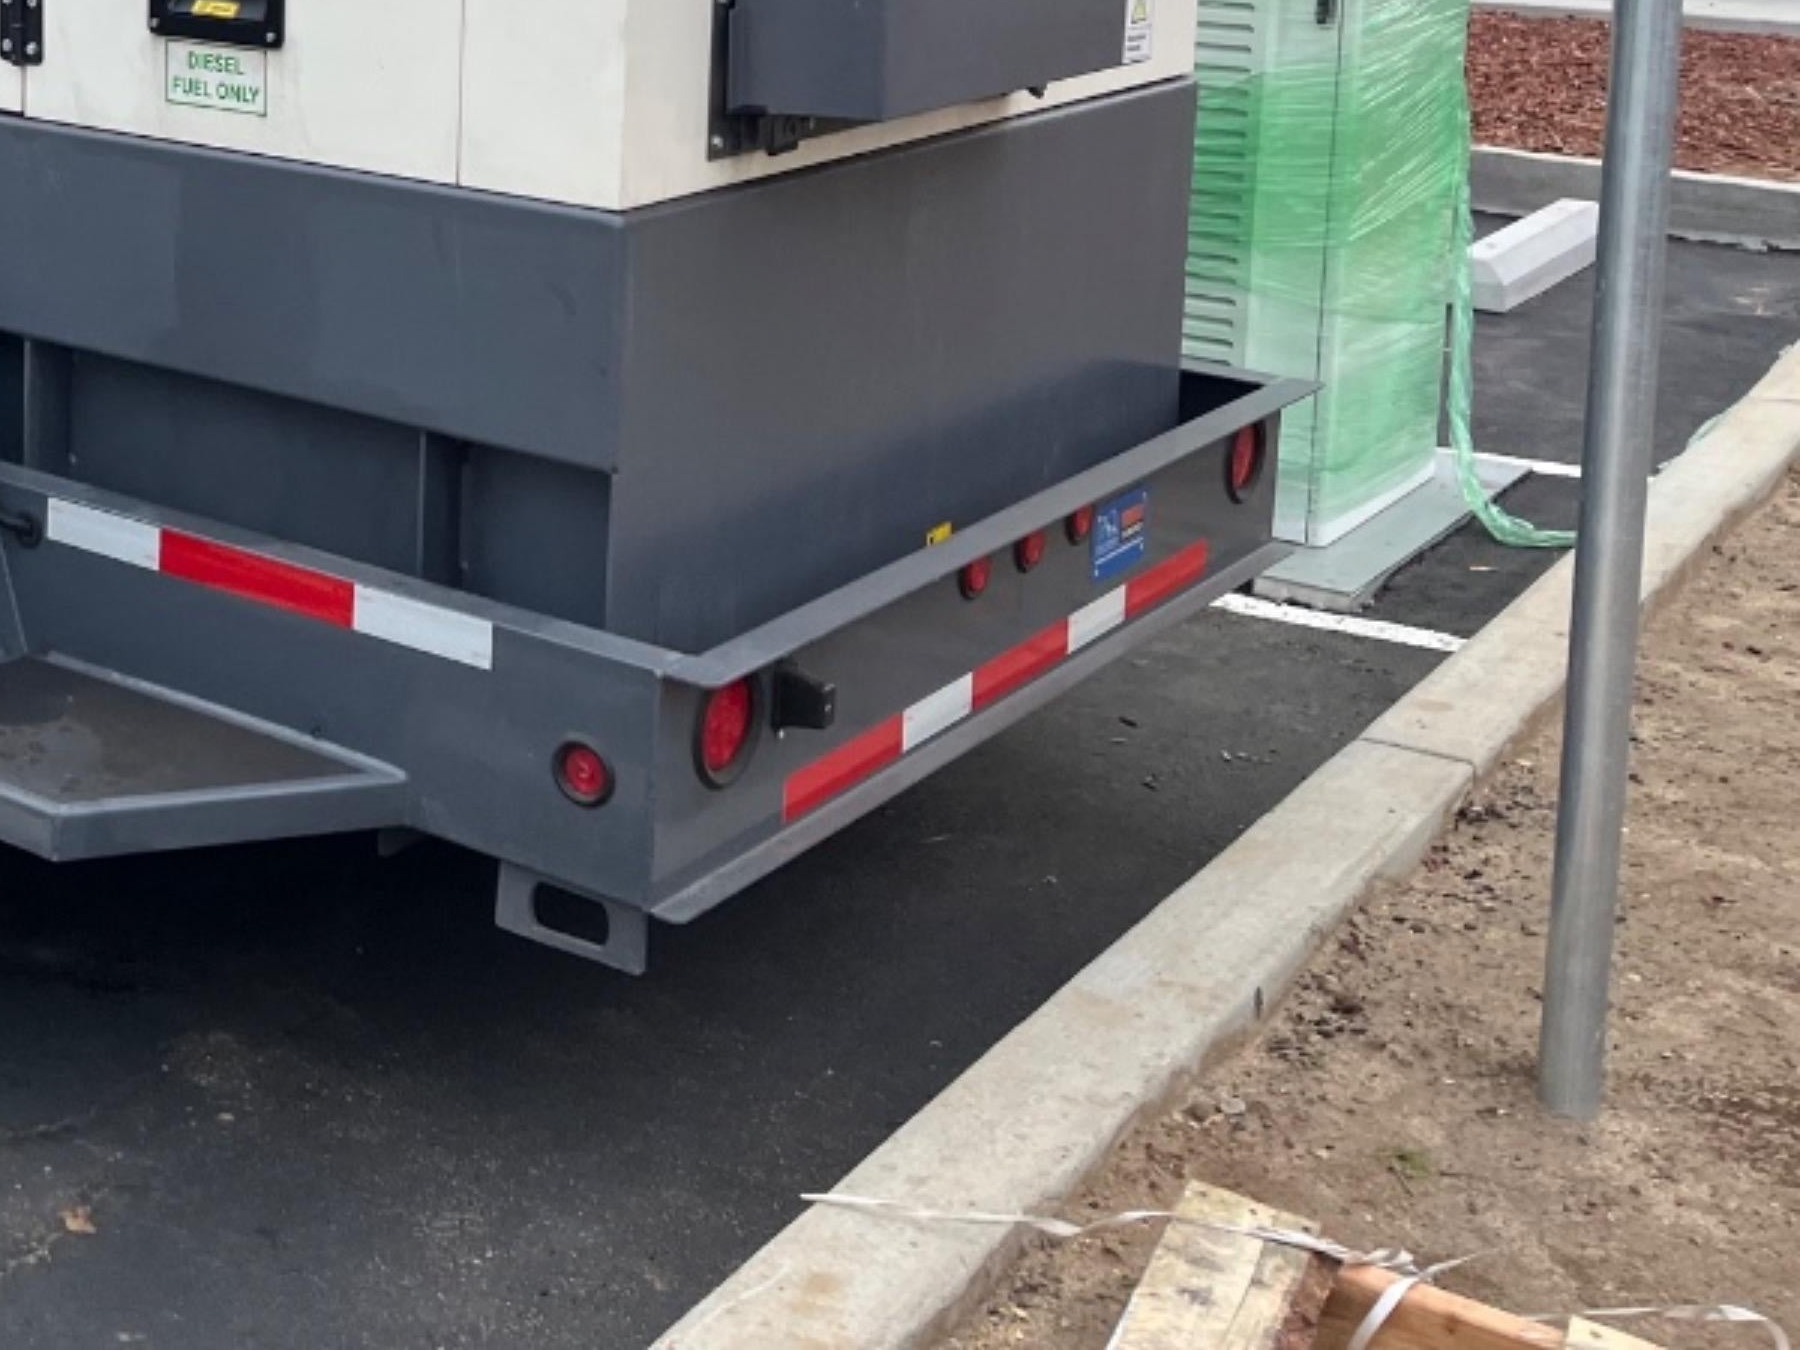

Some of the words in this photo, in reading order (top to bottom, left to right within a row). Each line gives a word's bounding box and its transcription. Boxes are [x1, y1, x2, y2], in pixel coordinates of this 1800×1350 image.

[188, 50, 245, 76] DIESEL
[173, 75, 212, 98] FUEL
[216, 81, 260, 104] ONLY
